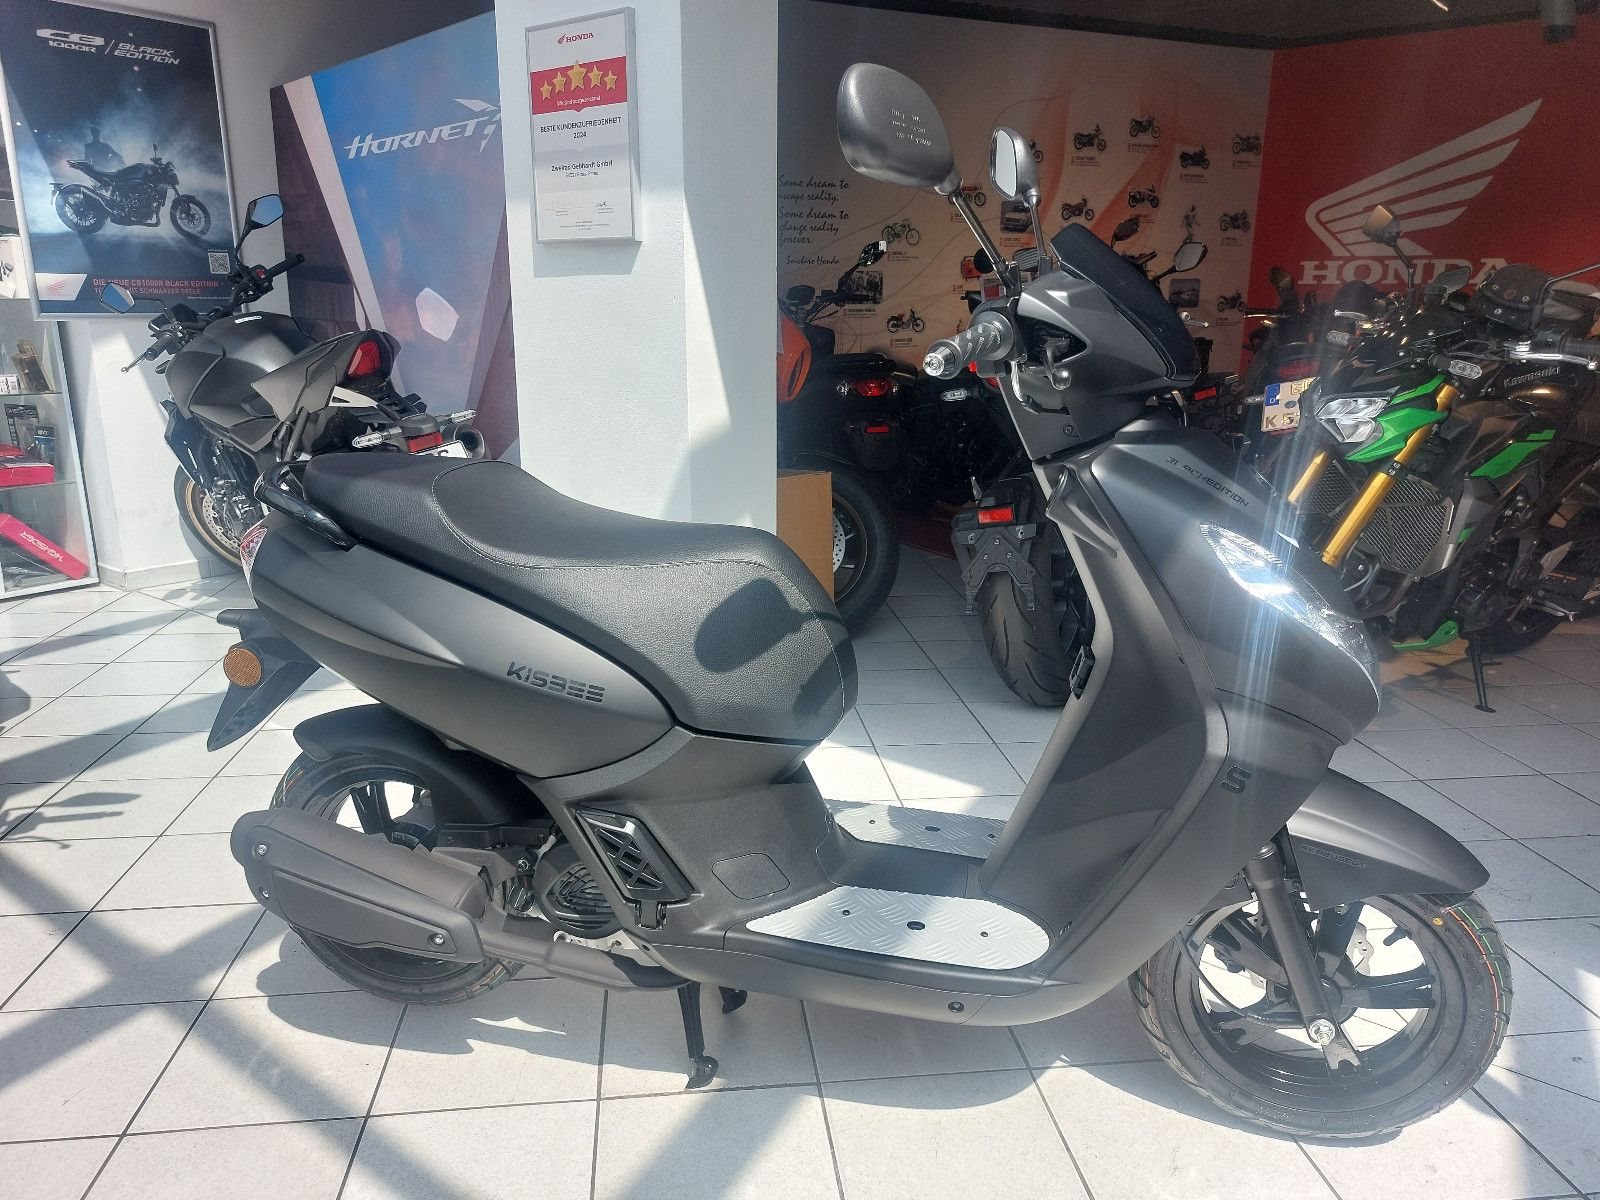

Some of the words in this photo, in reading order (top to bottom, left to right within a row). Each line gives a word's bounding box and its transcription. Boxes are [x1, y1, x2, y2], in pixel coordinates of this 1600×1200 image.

[36, 28, 105, 46] CB
[565, 32, 594, 43] HONDA
[48, 41, 97, 53] 1000R
[117, 42, 176, 57] BLACK
[114, 50, 181, 65] EDITION
[540, 124, 556, 133] BESTE
[343, 116, 490, 160] HORNET
[778, 174, 804, 188] Some
[806, 175, 837, 189] dream
[839, 180, 849, 190] to
[778, 206, 804, 219] Some
[806, 207, 837, 219] dream
[838, 210, 849, 220] to
[809, 220, 840, 237] reality
[817, 255, 840, 267] Honda
[93, 278, 107, 287] DIE
[191, 280, 219, 288] EDITION
[1503, 366, 1561, 389] Kawasaki
[1265, 414, 1279, 429] K
[1220, 765, 1252, 794] S
